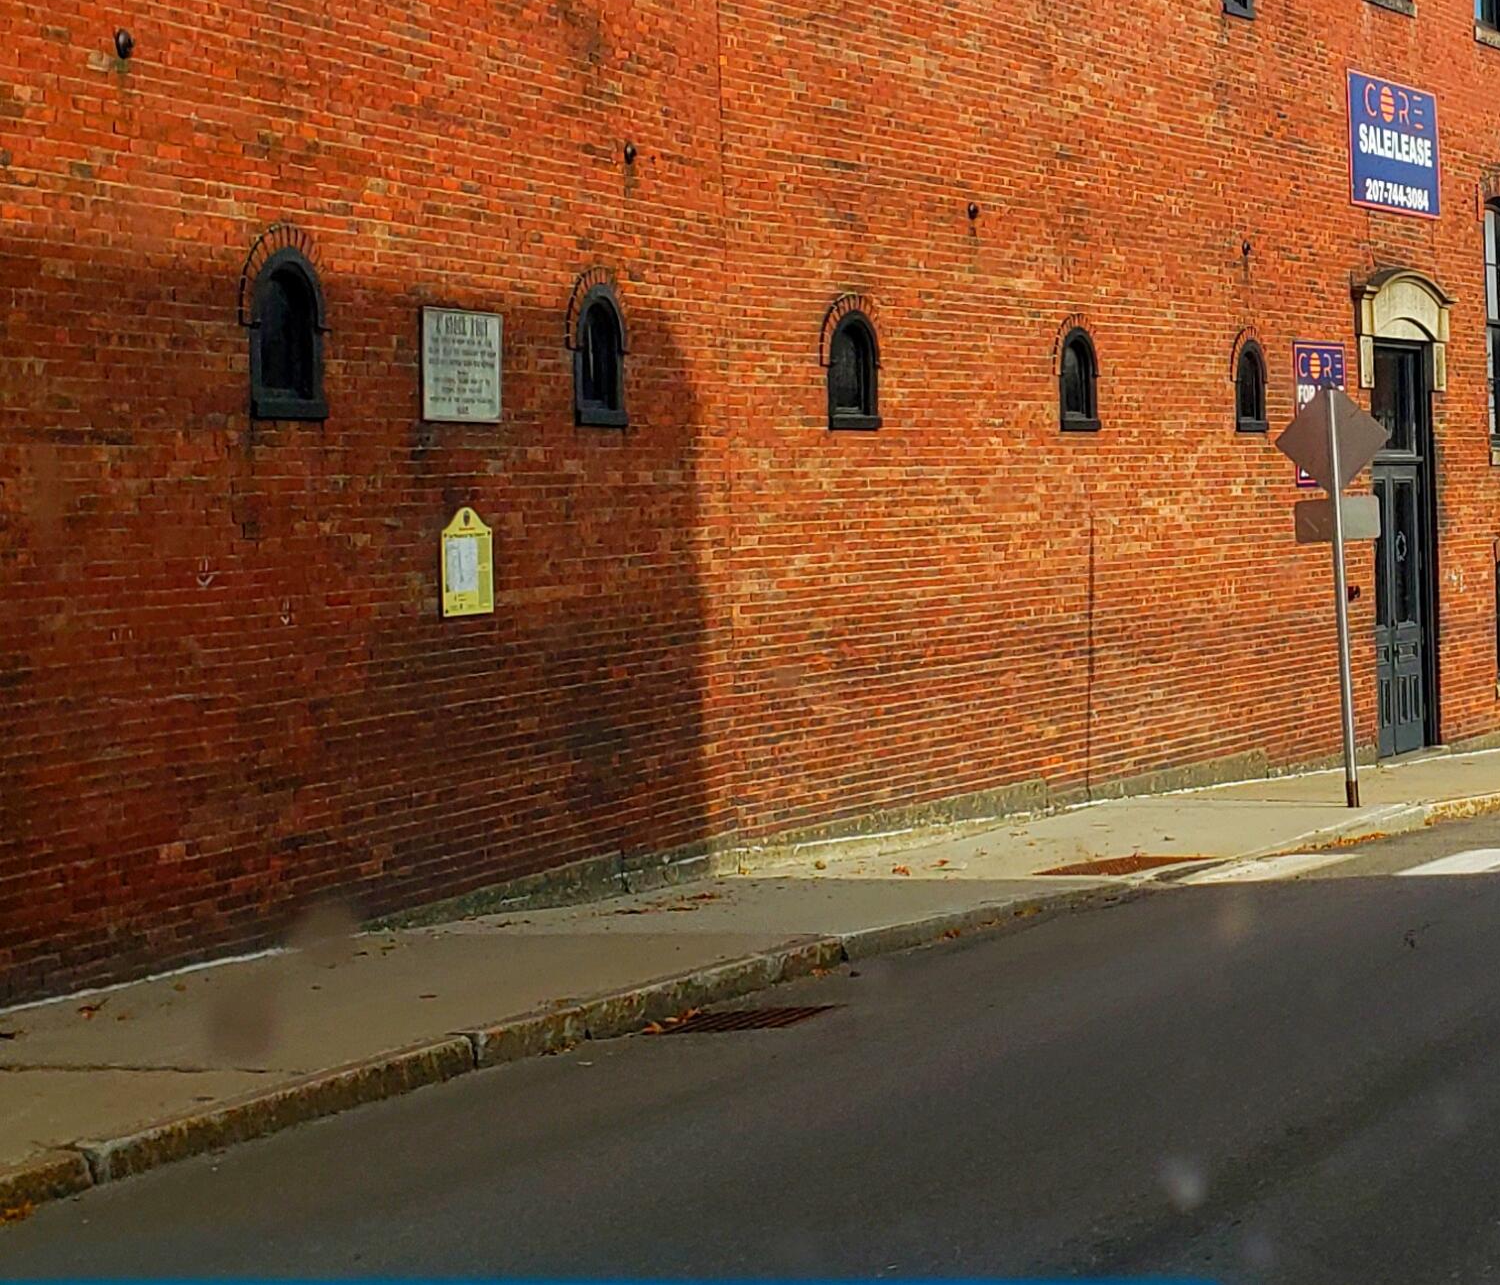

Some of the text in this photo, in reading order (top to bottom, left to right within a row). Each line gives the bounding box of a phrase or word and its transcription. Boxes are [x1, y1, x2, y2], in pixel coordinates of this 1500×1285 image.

[1364, 82, 1424, 130] CORE
[1359, 123, 1432, 168] SALE/LEASE
[1365, 178, 1430, 211] 207-744-3084
[1298, 351, 1343, 380] CORE
